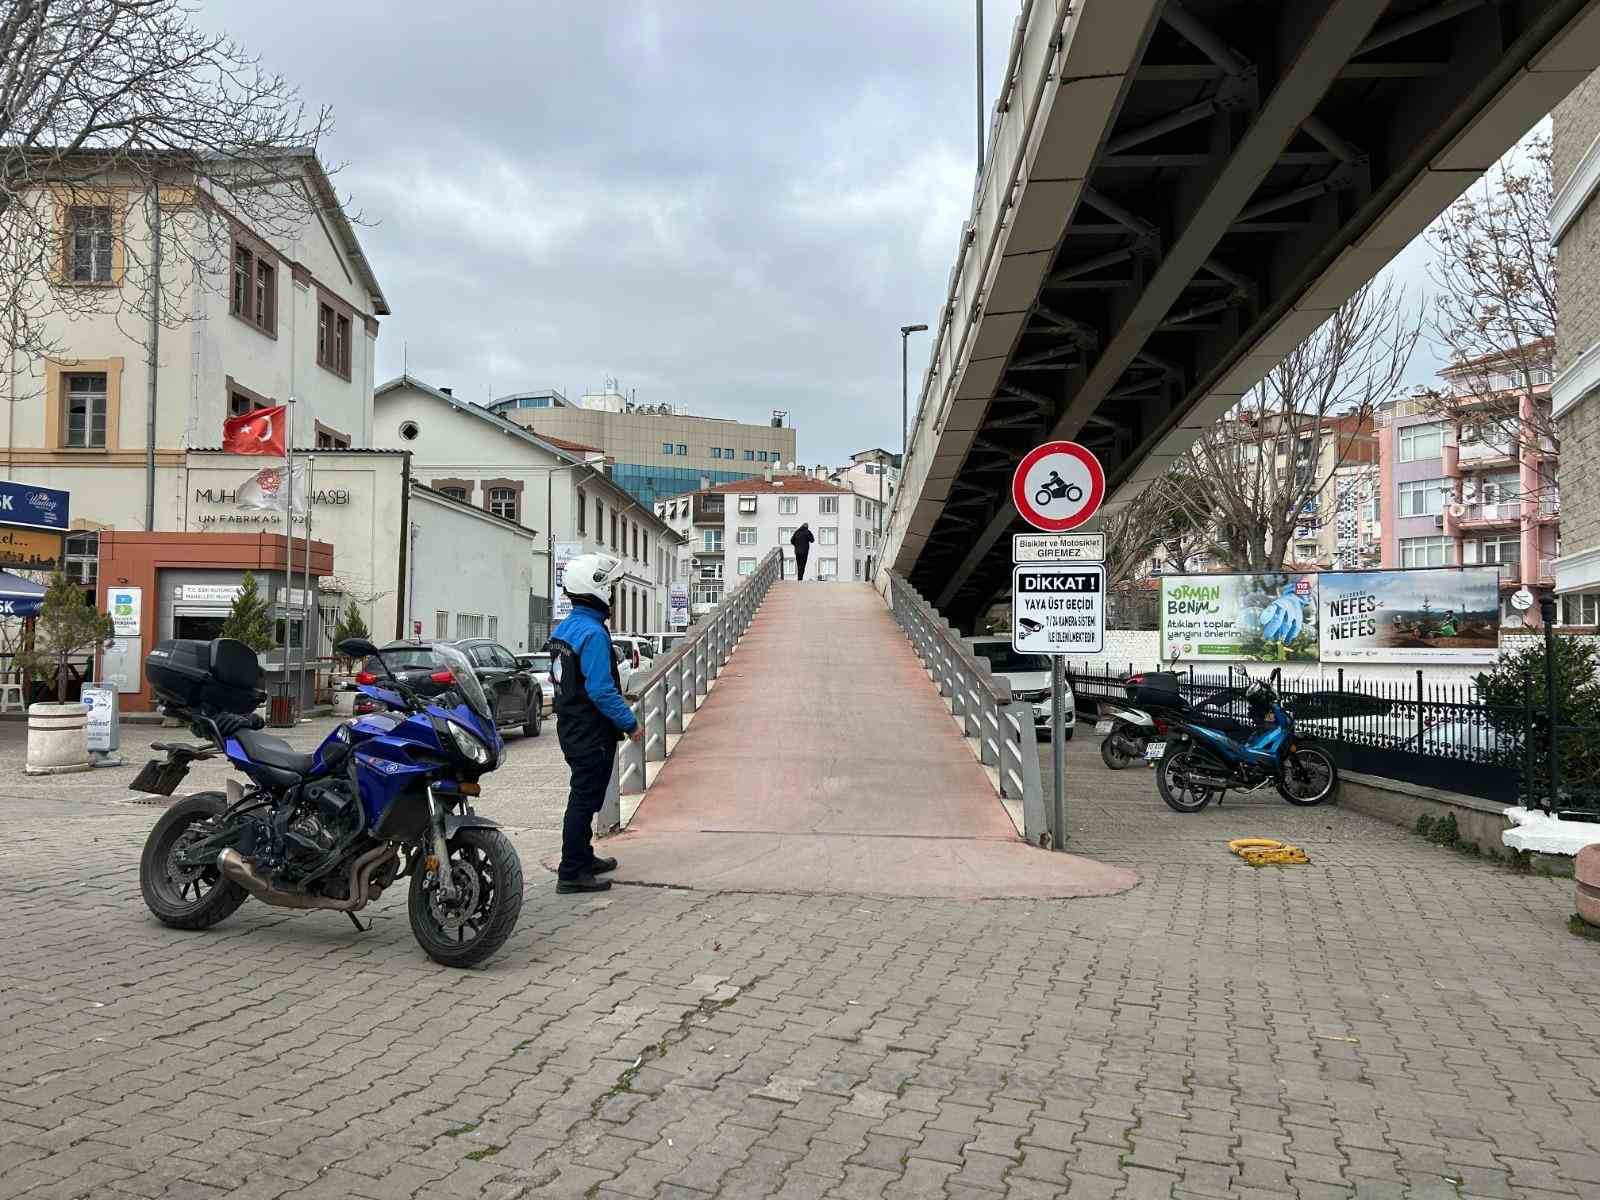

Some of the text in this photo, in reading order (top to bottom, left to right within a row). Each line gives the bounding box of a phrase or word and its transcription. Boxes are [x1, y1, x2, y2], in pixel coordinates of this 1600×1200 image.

[1020, 539, 1047, 548] Bisiklet
[1060, 538, 1100, 548] Motosiklet
[1024, 574, 1086, 590] DİKKAT
[1167, 584, 1220, 600] ORMAN
[1025, 596, 1094, 612] YAYA ÜST GEÇİDİ
[1330, 594, 1376, 617] NEFES
[1330, 618, 1376, 640] NEFES
